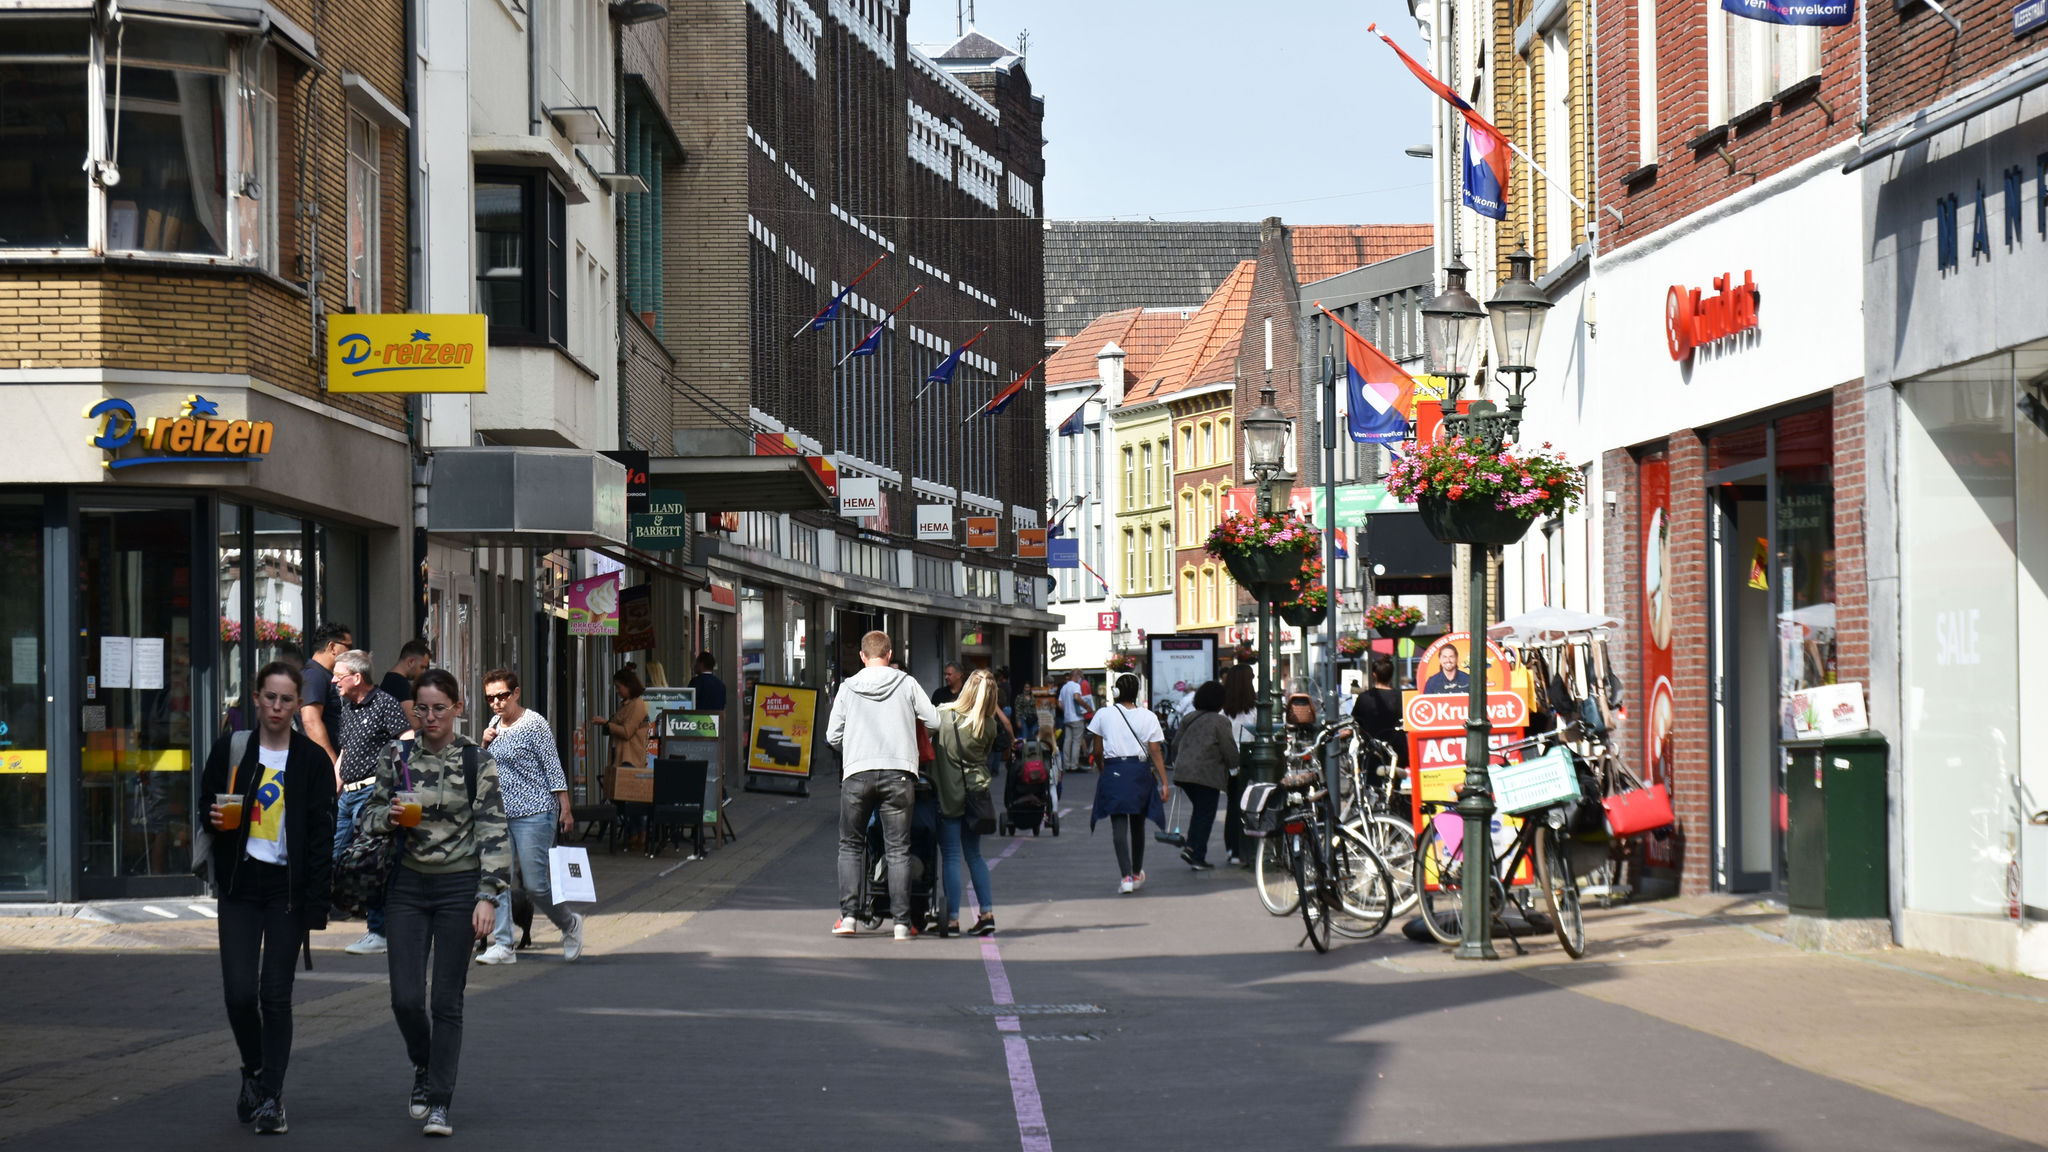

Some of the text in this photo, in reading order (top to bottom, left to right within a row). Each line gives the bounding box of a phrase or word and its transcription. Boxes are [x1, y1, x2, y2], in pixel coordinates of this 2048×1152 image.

[338, 330, 473, 365] D-reizen
[87, 395, 274, 454] D-reizen
[843, 498, 875, 508] HEMA
[636, 526, 681, 537] BARRETT
[654, 516, 663, 526] &
[919, 523, 949, 532] HEMA
[1936, 608, 1980, 666] SALE
[1437, 700, 1516, 721] Kruvat
[1422, 734, 1510, 764] ACTE!
